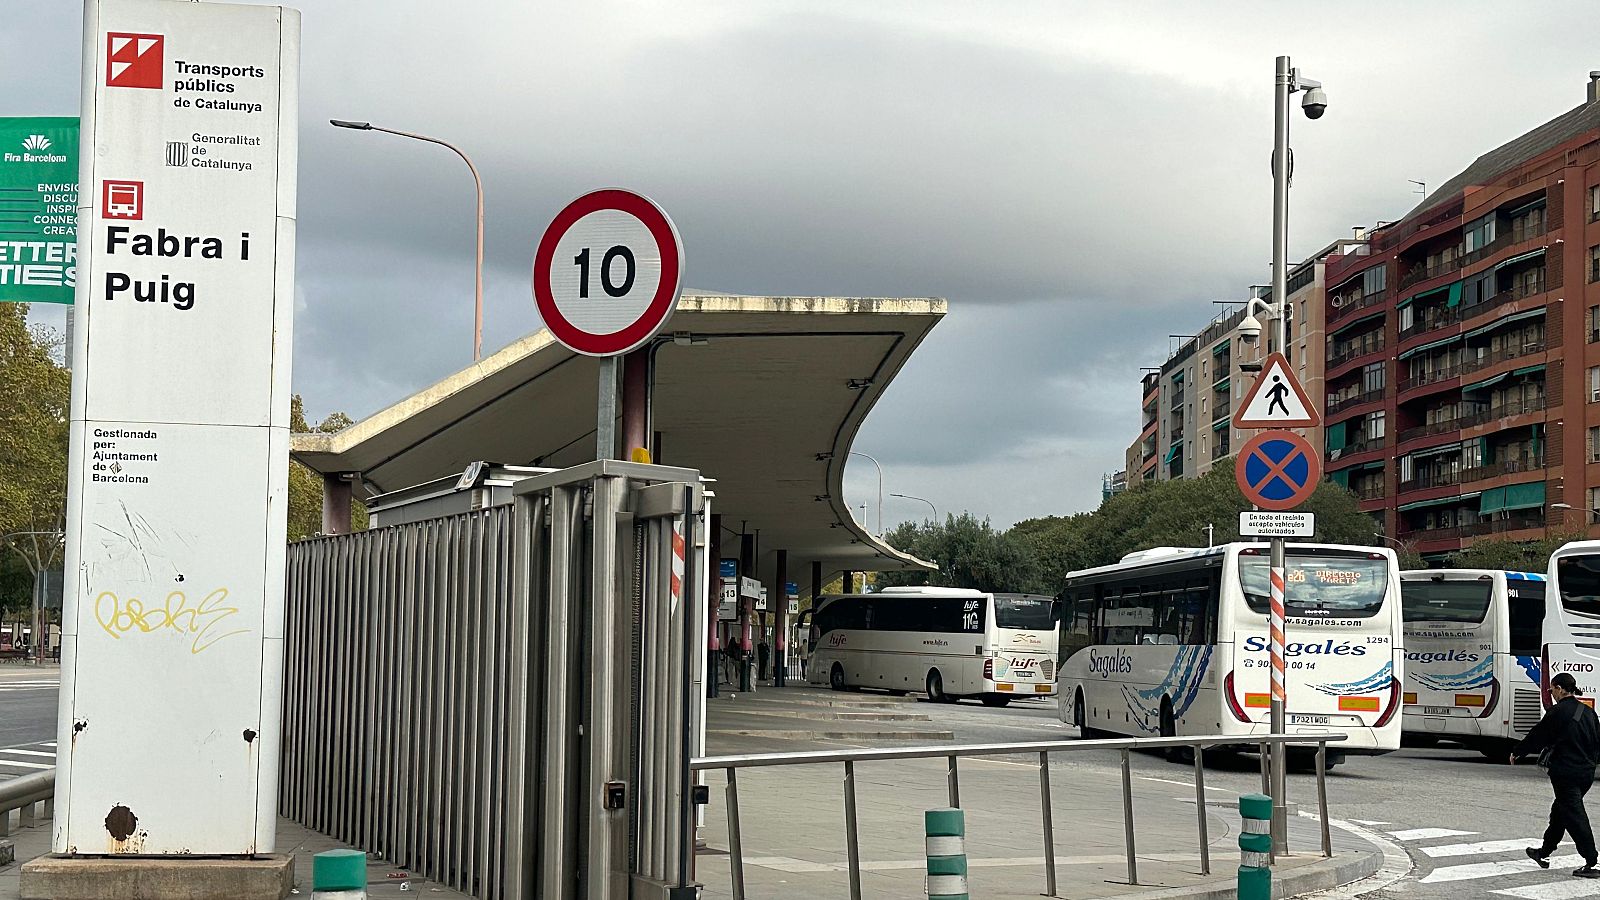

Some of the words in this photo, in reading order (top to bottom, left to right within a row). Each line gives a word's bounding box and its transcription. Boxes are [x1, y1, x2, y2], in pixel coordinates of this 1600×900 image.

[174, 60, 264, 79] Transports
[174, 78, 235, 93] públics
[173, 97, 191, 108] de
[195, 98, 262, 114] Catalunya
[191, 132, 261, 146] Generalitat
[191, 145, 207, 155] de
[4, 152, 21, 163] Fira
[23, 152, 67, 163] Barcelona
[191, 158, 252, 172] Catalunya
[106, 225, 223, 260] Fabra
[240, 231, 250, 261] i
[574, 245, 636, 299] 10
[105, 272, 195, 311] Puig
[93, 428, 157, 440] Gestionada
[93, 441, 116, 451] per:
[92, 451, 158, 462] Ajuntament
[92, 462, 107, 471] de
[92, 473, 149, 484] Barcelona
[726, 590, 736, 598] 13
[1508, 588, 1519, 598] 901
[1243, 636, 1367, 657] Sgalés
[1365, 636, 1389, 644] 1294
[1088, 647, 1132, 678] Sagalés
[1404, 649, 1479, 664] agalés
[1291, 661, 1303, 669] 00
[1305, 662, 1316, 670] 14
[1563, 659, 1594, 672] izaro
